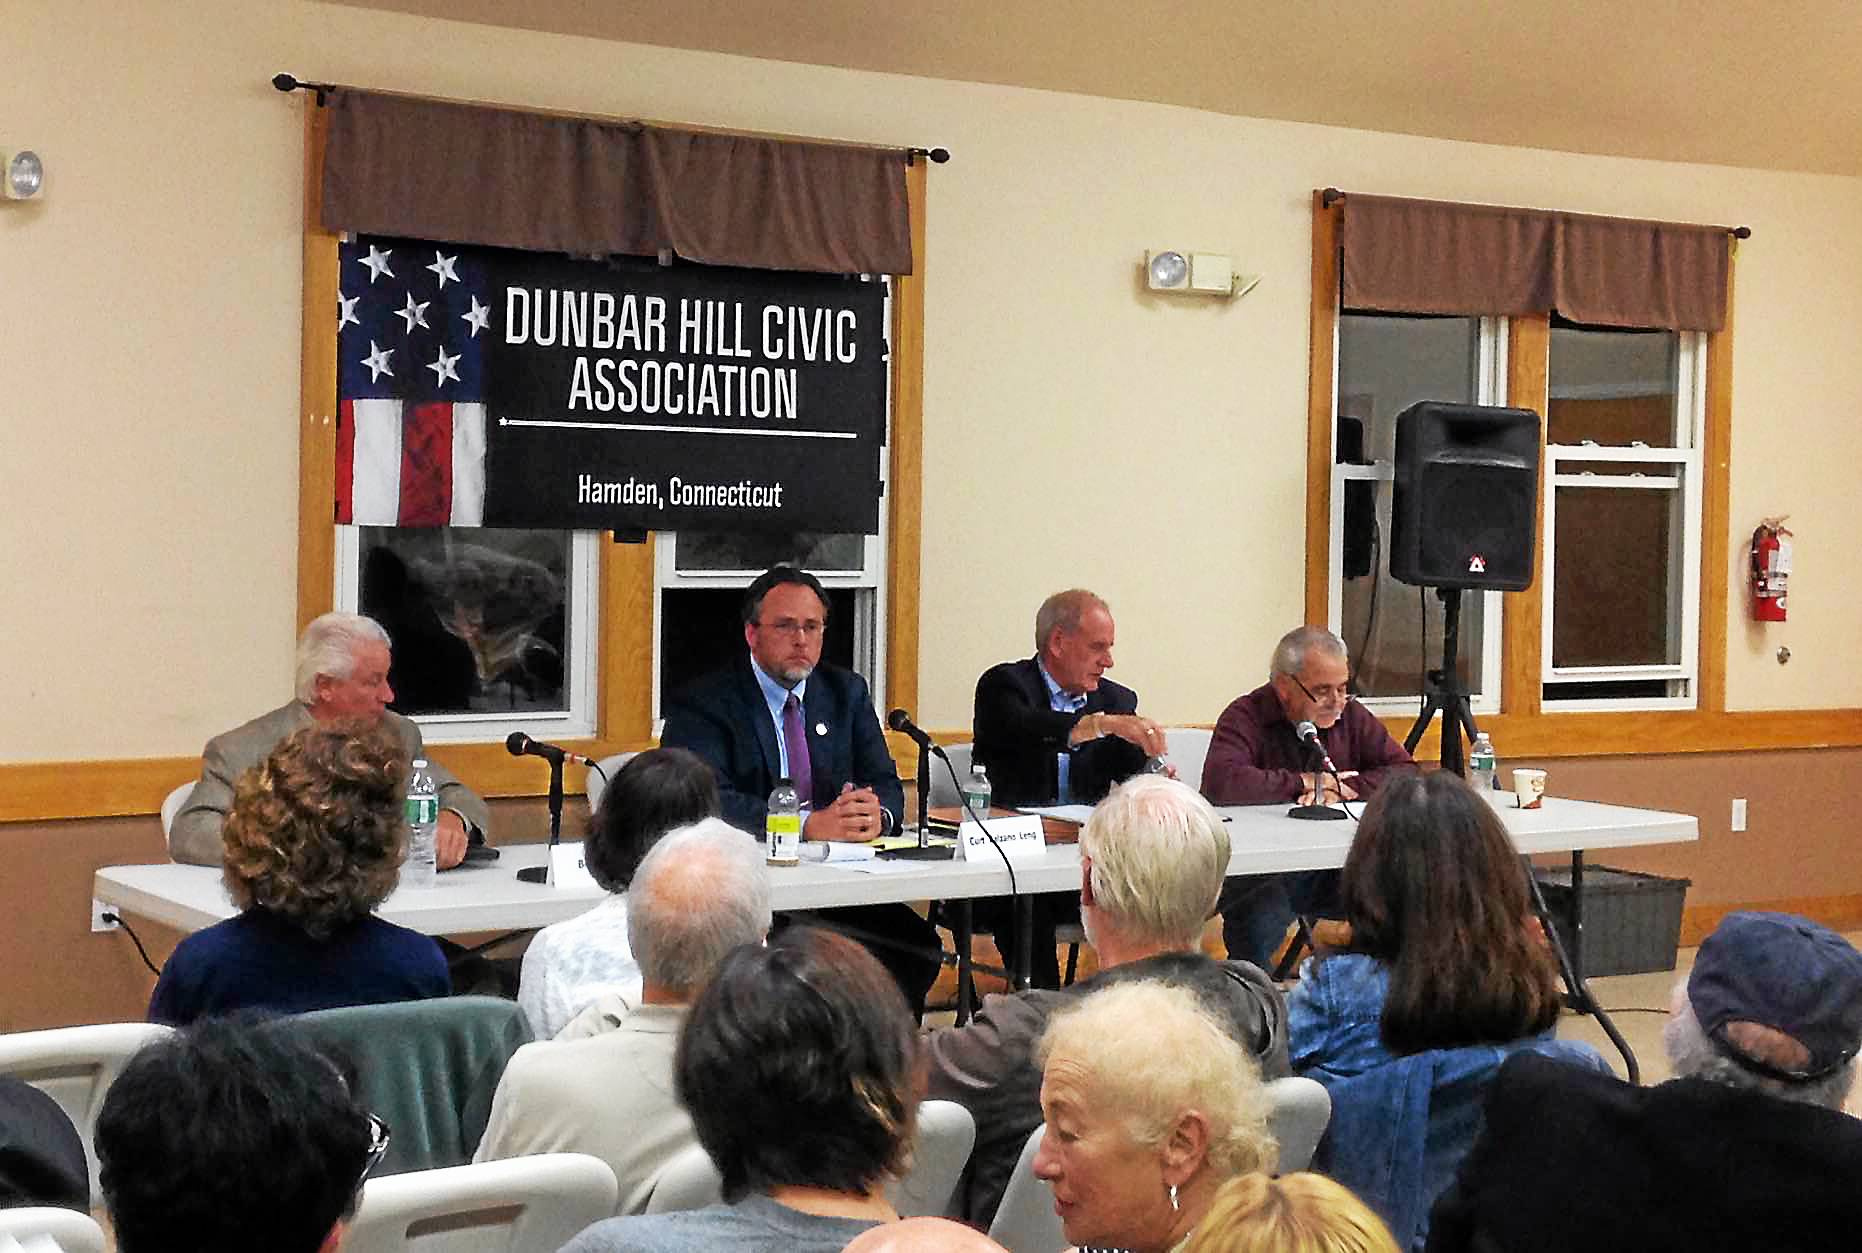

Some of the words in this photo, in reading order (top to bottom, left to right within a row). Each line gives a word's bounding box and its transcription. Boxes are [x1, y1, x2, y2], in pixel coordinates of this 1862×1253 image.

[505, 286, 666, 353] DUNBAR
[679, 298, 752, 358] HILL
[762, 305, 857, 364] CIVIC
[568, 356, 797, 419] ASSOCIATION
[578, 474, 664, 510] Hamden,
[669, 476, 783, 508] Connecticut
